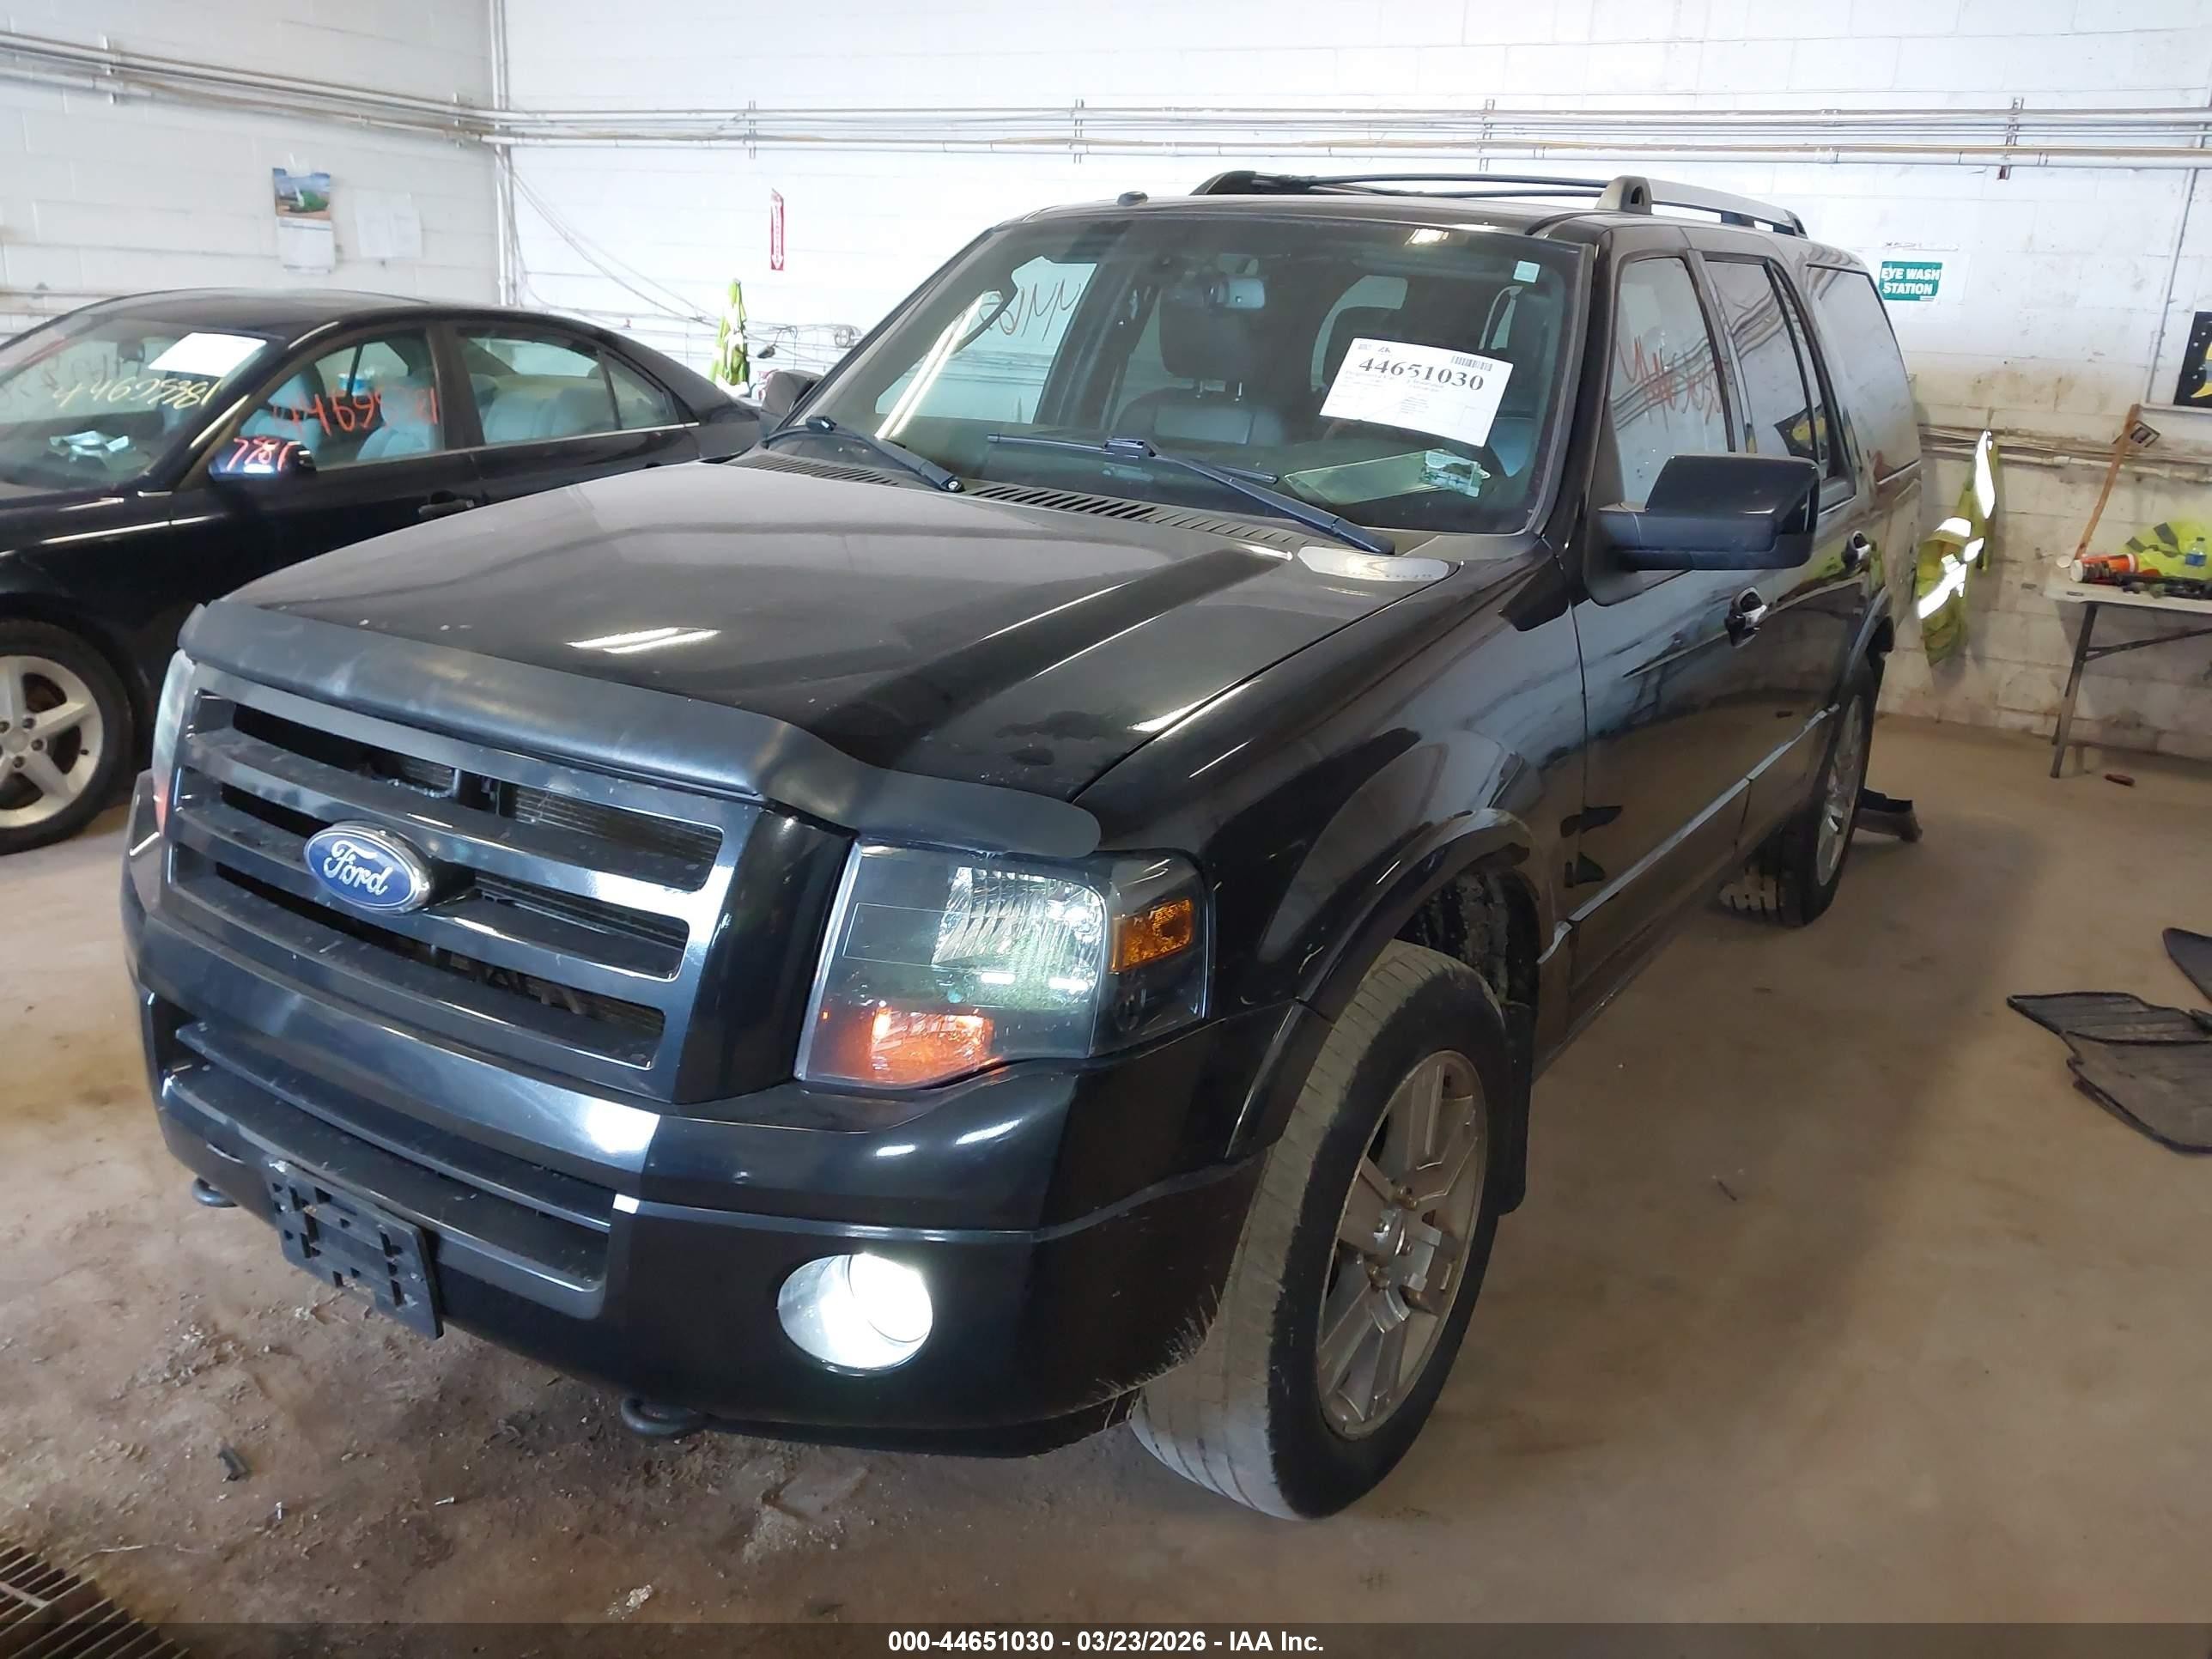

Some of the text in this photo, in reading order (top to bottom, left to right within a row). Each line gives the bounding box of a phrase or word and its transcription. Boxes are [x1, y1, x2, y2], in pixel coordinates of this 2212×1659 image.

[1881, 268, 1942, 281] EYE WASH
[1882, 283, 1934, 295] STATION
[1358, 357, 1485, 391] 44651030
[324, 840, 393, 896] Ford
